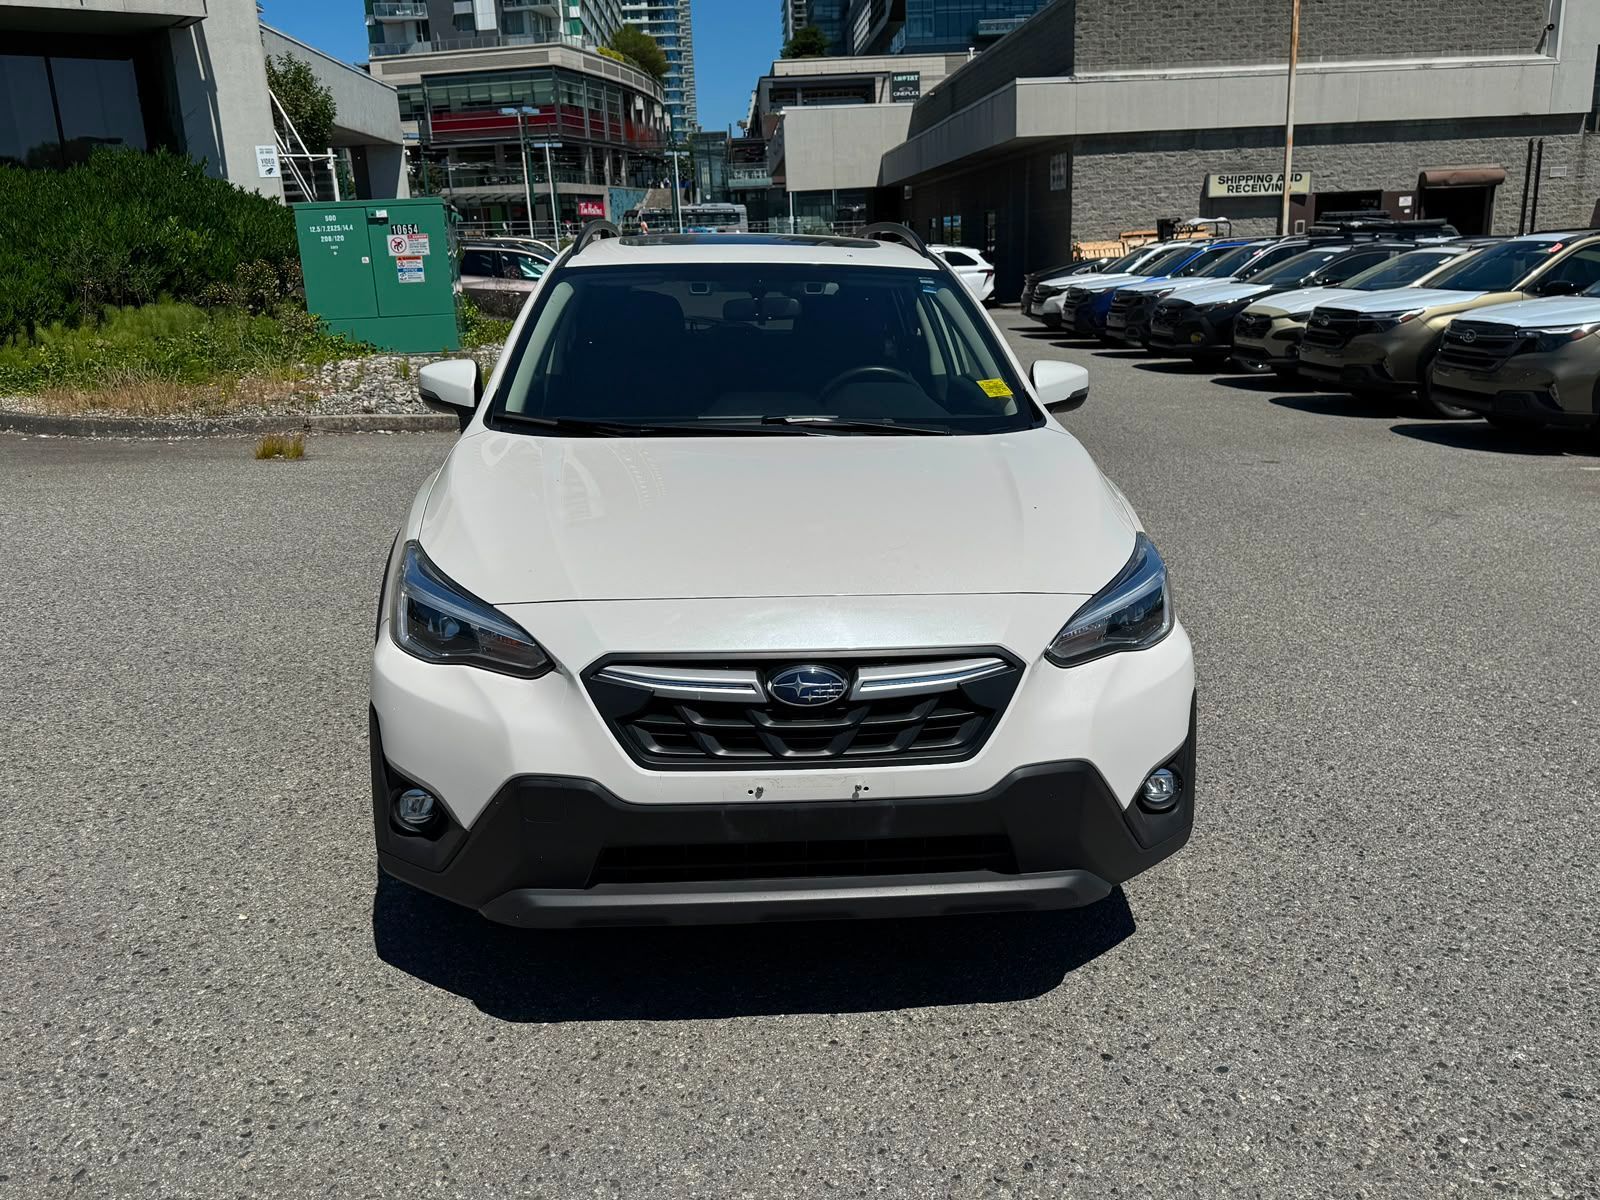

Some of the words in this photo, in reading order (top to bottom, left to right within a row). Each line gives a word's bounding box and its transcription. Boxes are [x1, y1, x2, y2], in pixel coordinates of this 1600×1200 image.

[1218, 174, 1273, 184] SHIPPING
[1227, 182, 1291, 193] RECEIVIN
[392, 224, 418, 234] 10654
